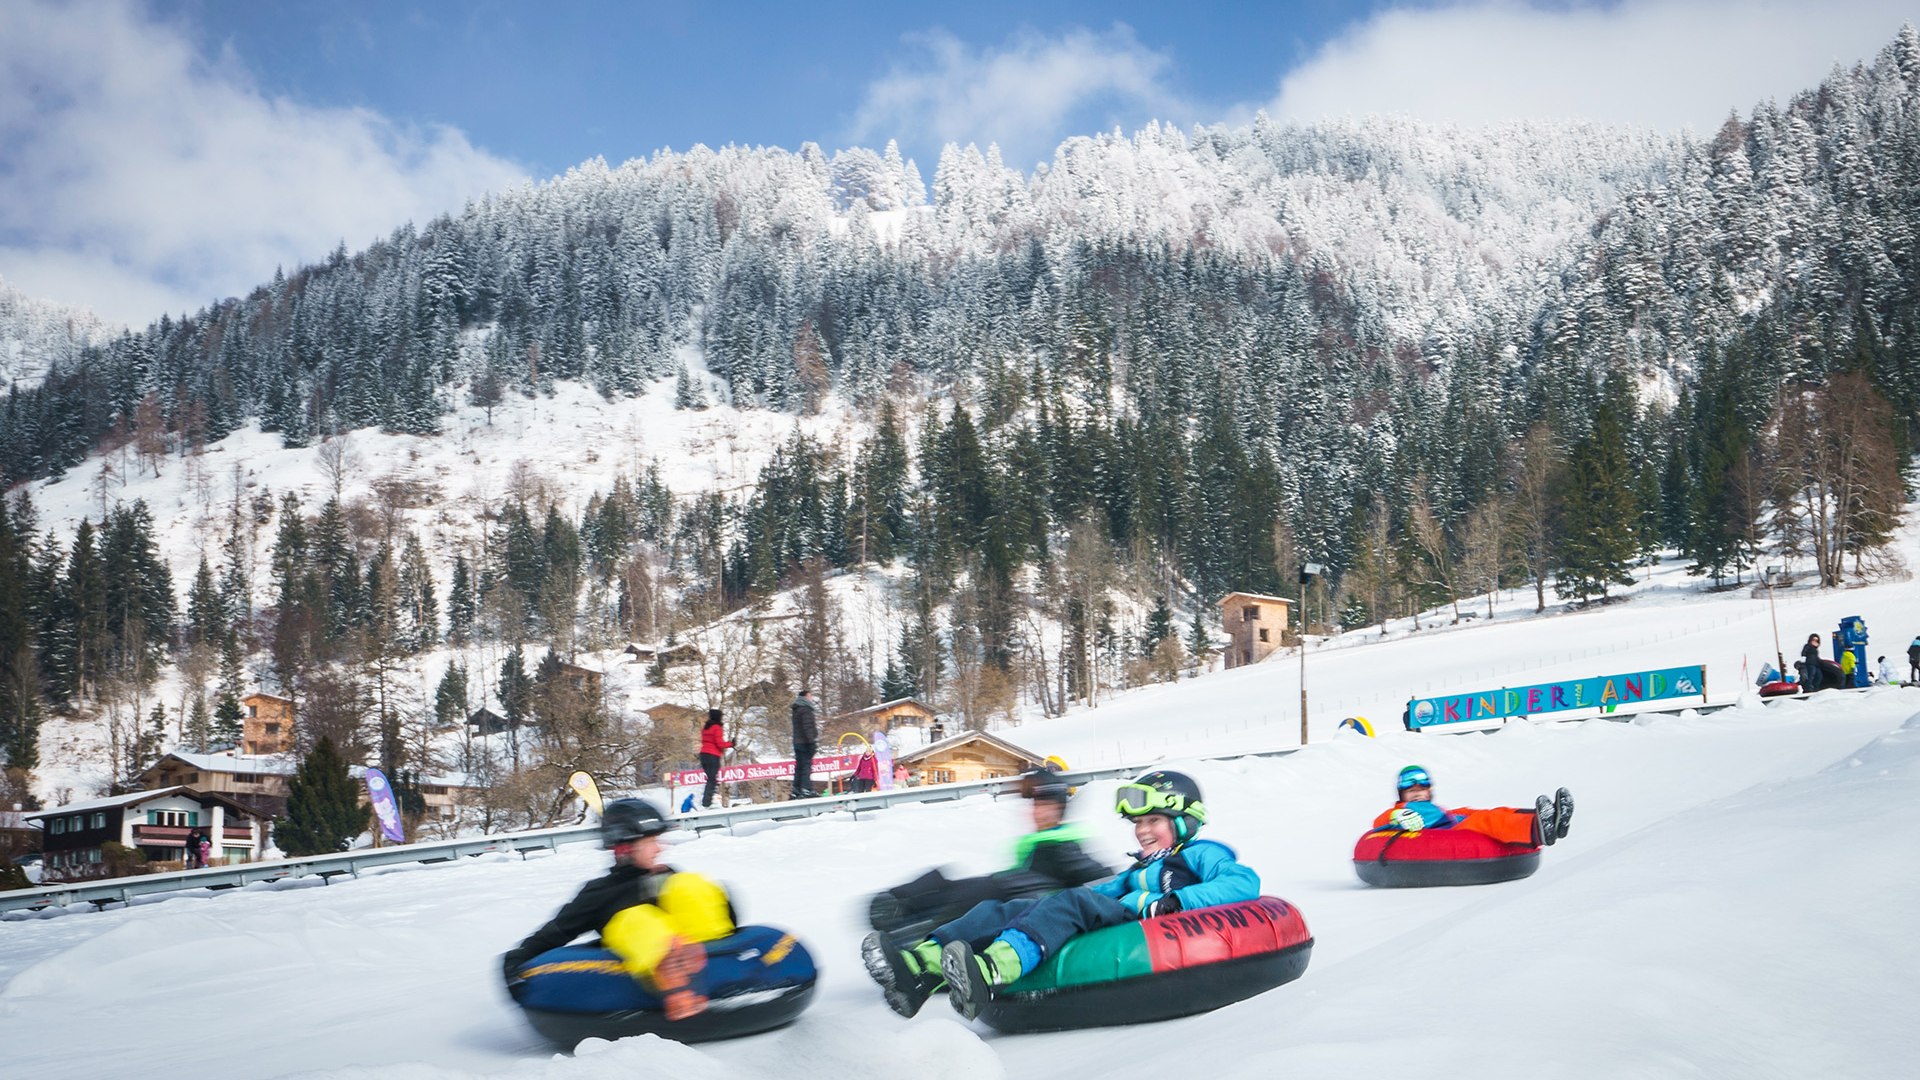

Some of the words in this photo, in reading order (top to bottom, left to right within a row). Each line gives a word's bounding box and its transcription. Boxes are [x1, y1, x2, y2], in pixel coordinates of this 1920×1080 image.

[1444, 673, 1667, 722] KINDERLAND
[684, 768, 745, 785] KINDLAND
[747, 765, 787, 778] Skischule
[788, 760, 840, 775] Bschzell
